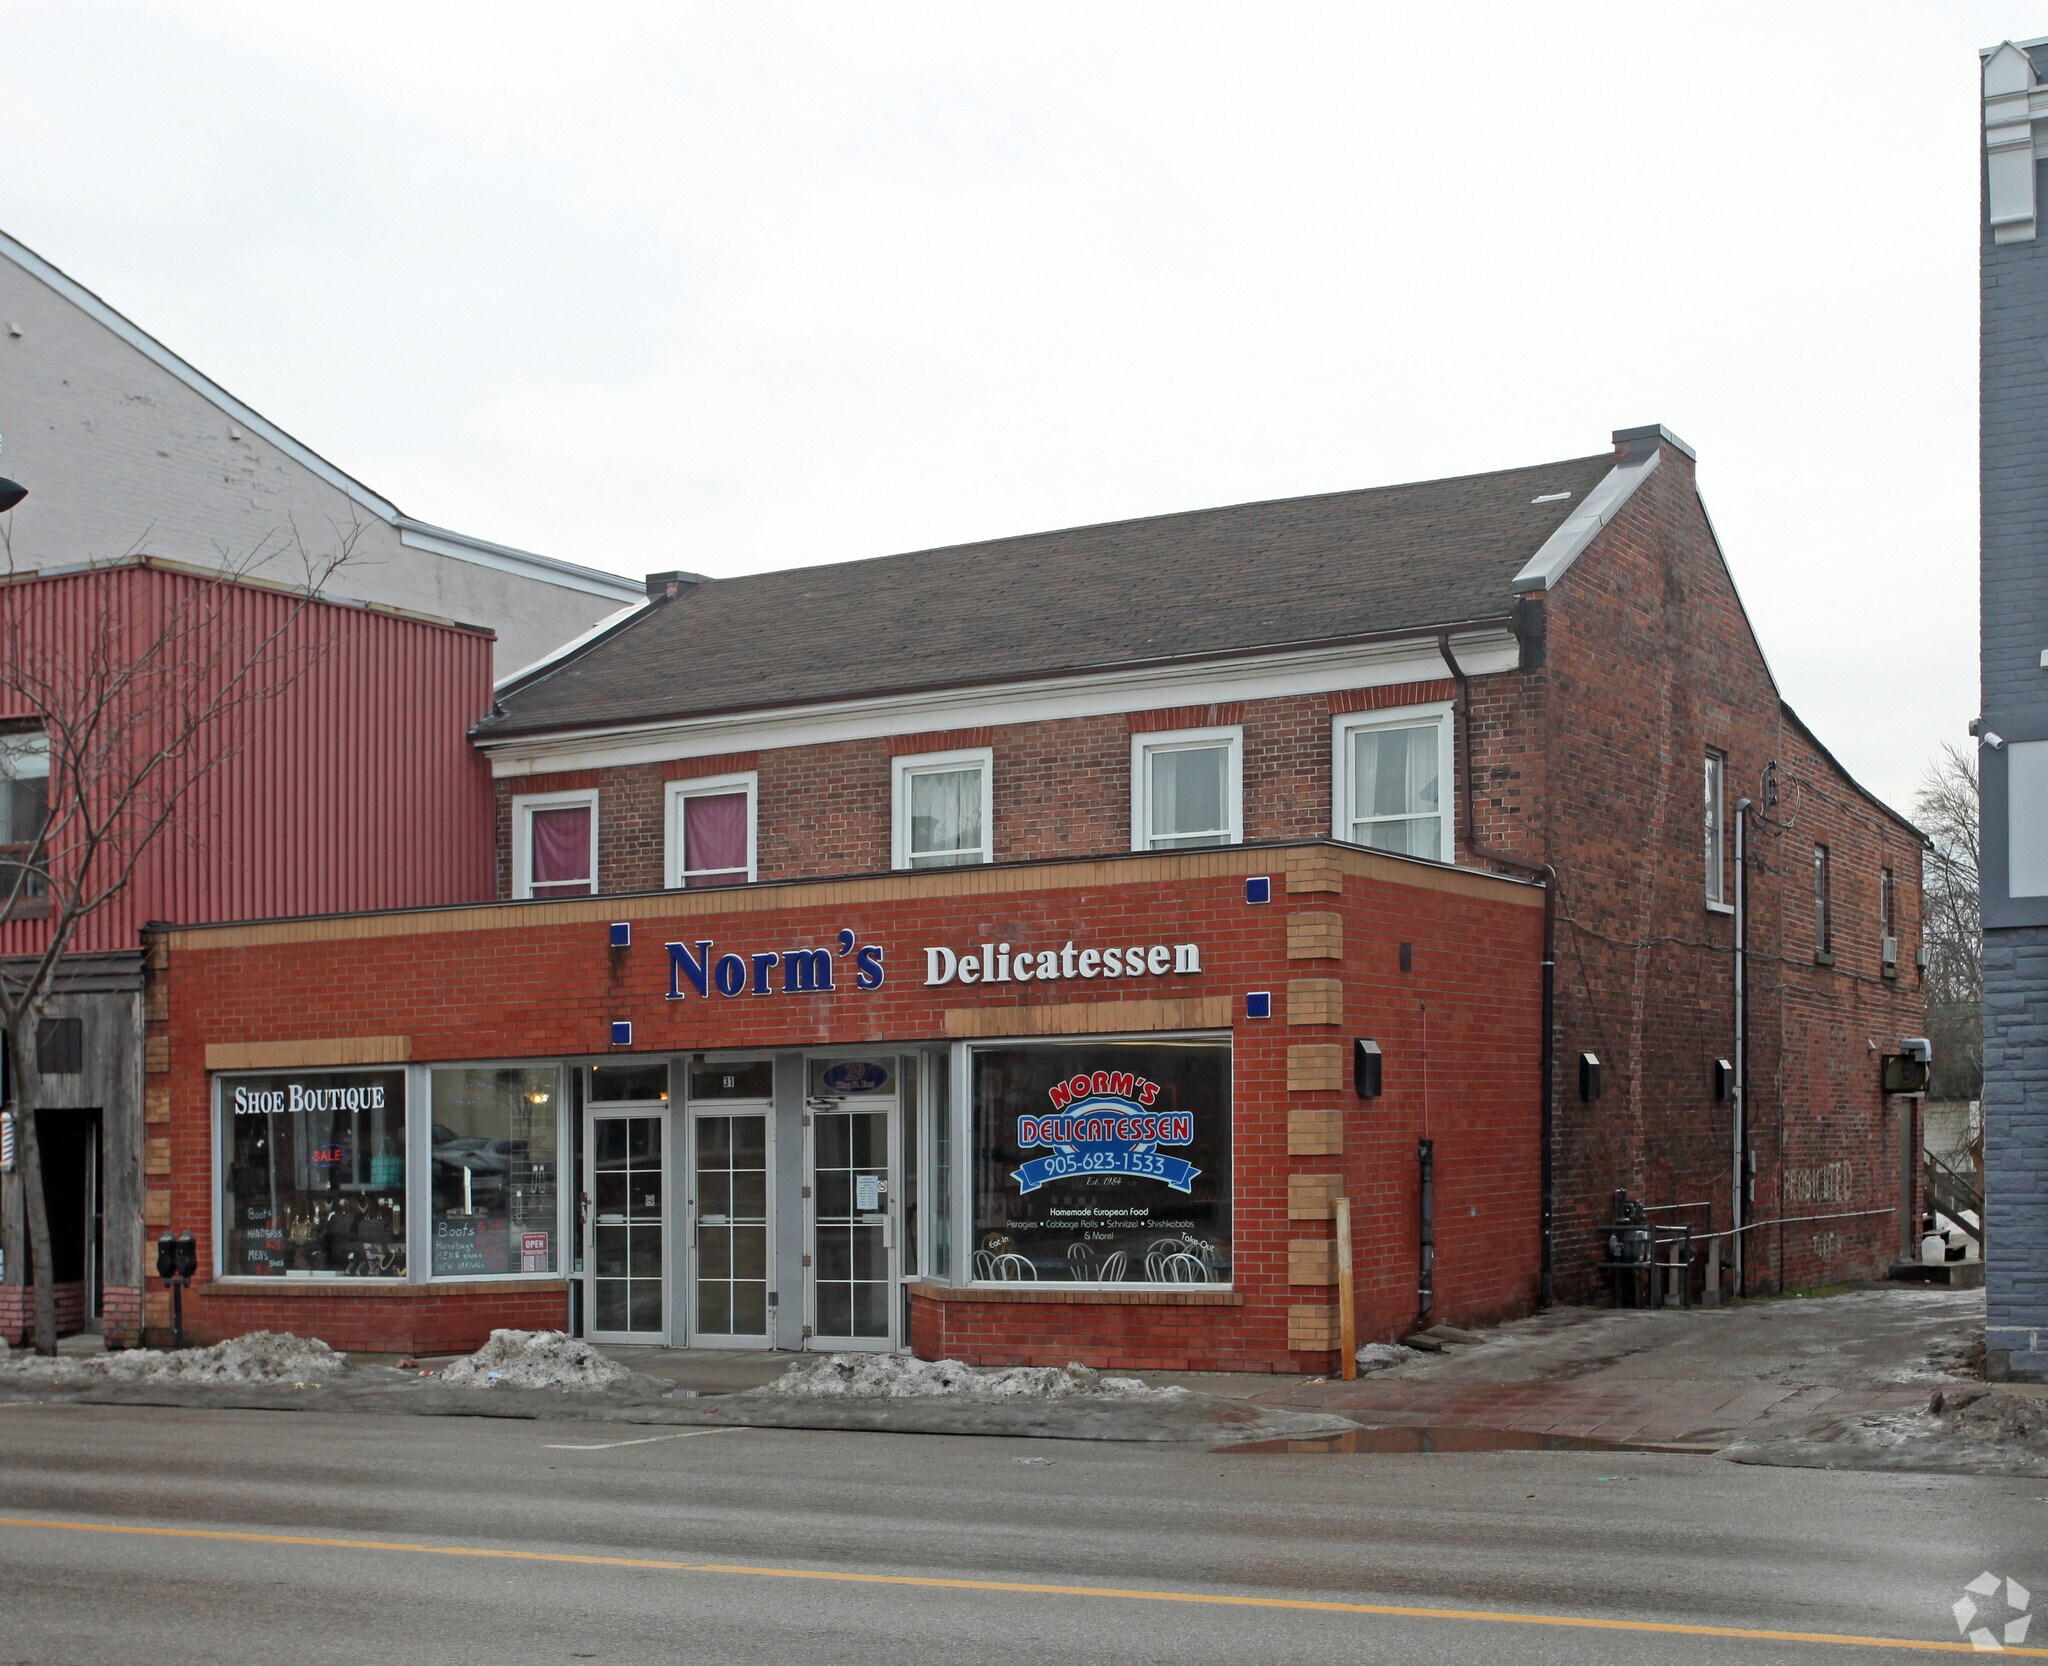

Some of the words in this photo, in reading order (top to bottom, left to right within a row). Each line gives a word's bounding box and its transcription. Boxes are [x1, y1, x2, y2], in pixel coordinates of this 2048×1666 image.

[665, 928, 884, 1000] Norm's
[924, 941, 1202, 986] Delicatessen
[723, 1076, 734, 1087] 31
[1049, 1071, 1160, 1110] NORM'S
[235, 1086, 284, 1115] SHOE
[288, 1084, 385, 1113] BOUTIQUE
[1021, 1116, 1189, 1143] DELICATESSEN
[312, 1149, 342, 1163] SALE
[1044, 1152, 1165, 1176] 905-623-1533
[1103, 1177, 1122, 1186] 1984
[248, 1207, 272, 1220] Boots
[1050, 1208, 1091, 1216] Homemade
[1093, 1208, 1128, 1218] European
[1130, 1208, 1149, 1216] Food
[438, 1222, 475, 1238] Boots
[1006, 1220, 1038, 1230] Perogies
[1046, 1220, 1079, 1230] Cabbage
[1080, 1220, 1098, 1228] Rolls
[1107, 1220, 1139, 1228] Schnitzel
[1147, 1220, 1194, 1228] Shishkabobs
[247, 1228, 283, 1239] HANDBAGS
[1084, 1231, 1091, 1240] &
[435, 1241, 474, 1252] Handbags
[525, 1240, 544, 1249] OPEN
[989, 1236, 1010, 1249] Eat-In
[1181, 1232, 1215, 1252] Take-Out
[435, 1251, 460, 1261] MENS
